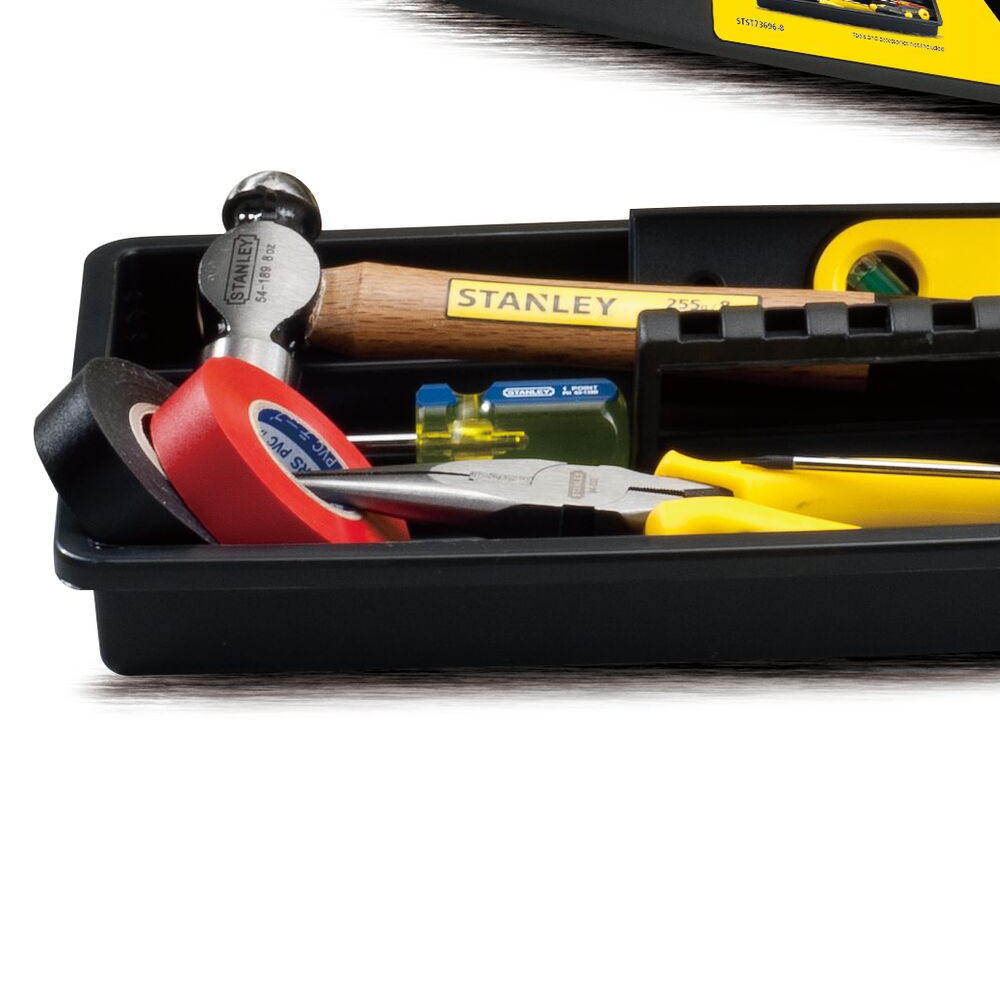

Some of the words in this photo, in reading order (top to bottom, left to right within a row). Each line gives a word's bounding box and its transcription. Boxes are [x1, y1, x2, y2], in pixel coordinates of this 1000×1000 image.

[736, 17, 785, 32] STST73696-8
[230, 238, 254, 300] STANLEY
[256, 265, 272, 303] 54-189
[457, 288, 617, 316] STANLEY
[266, 436, 293, 459] PVC
